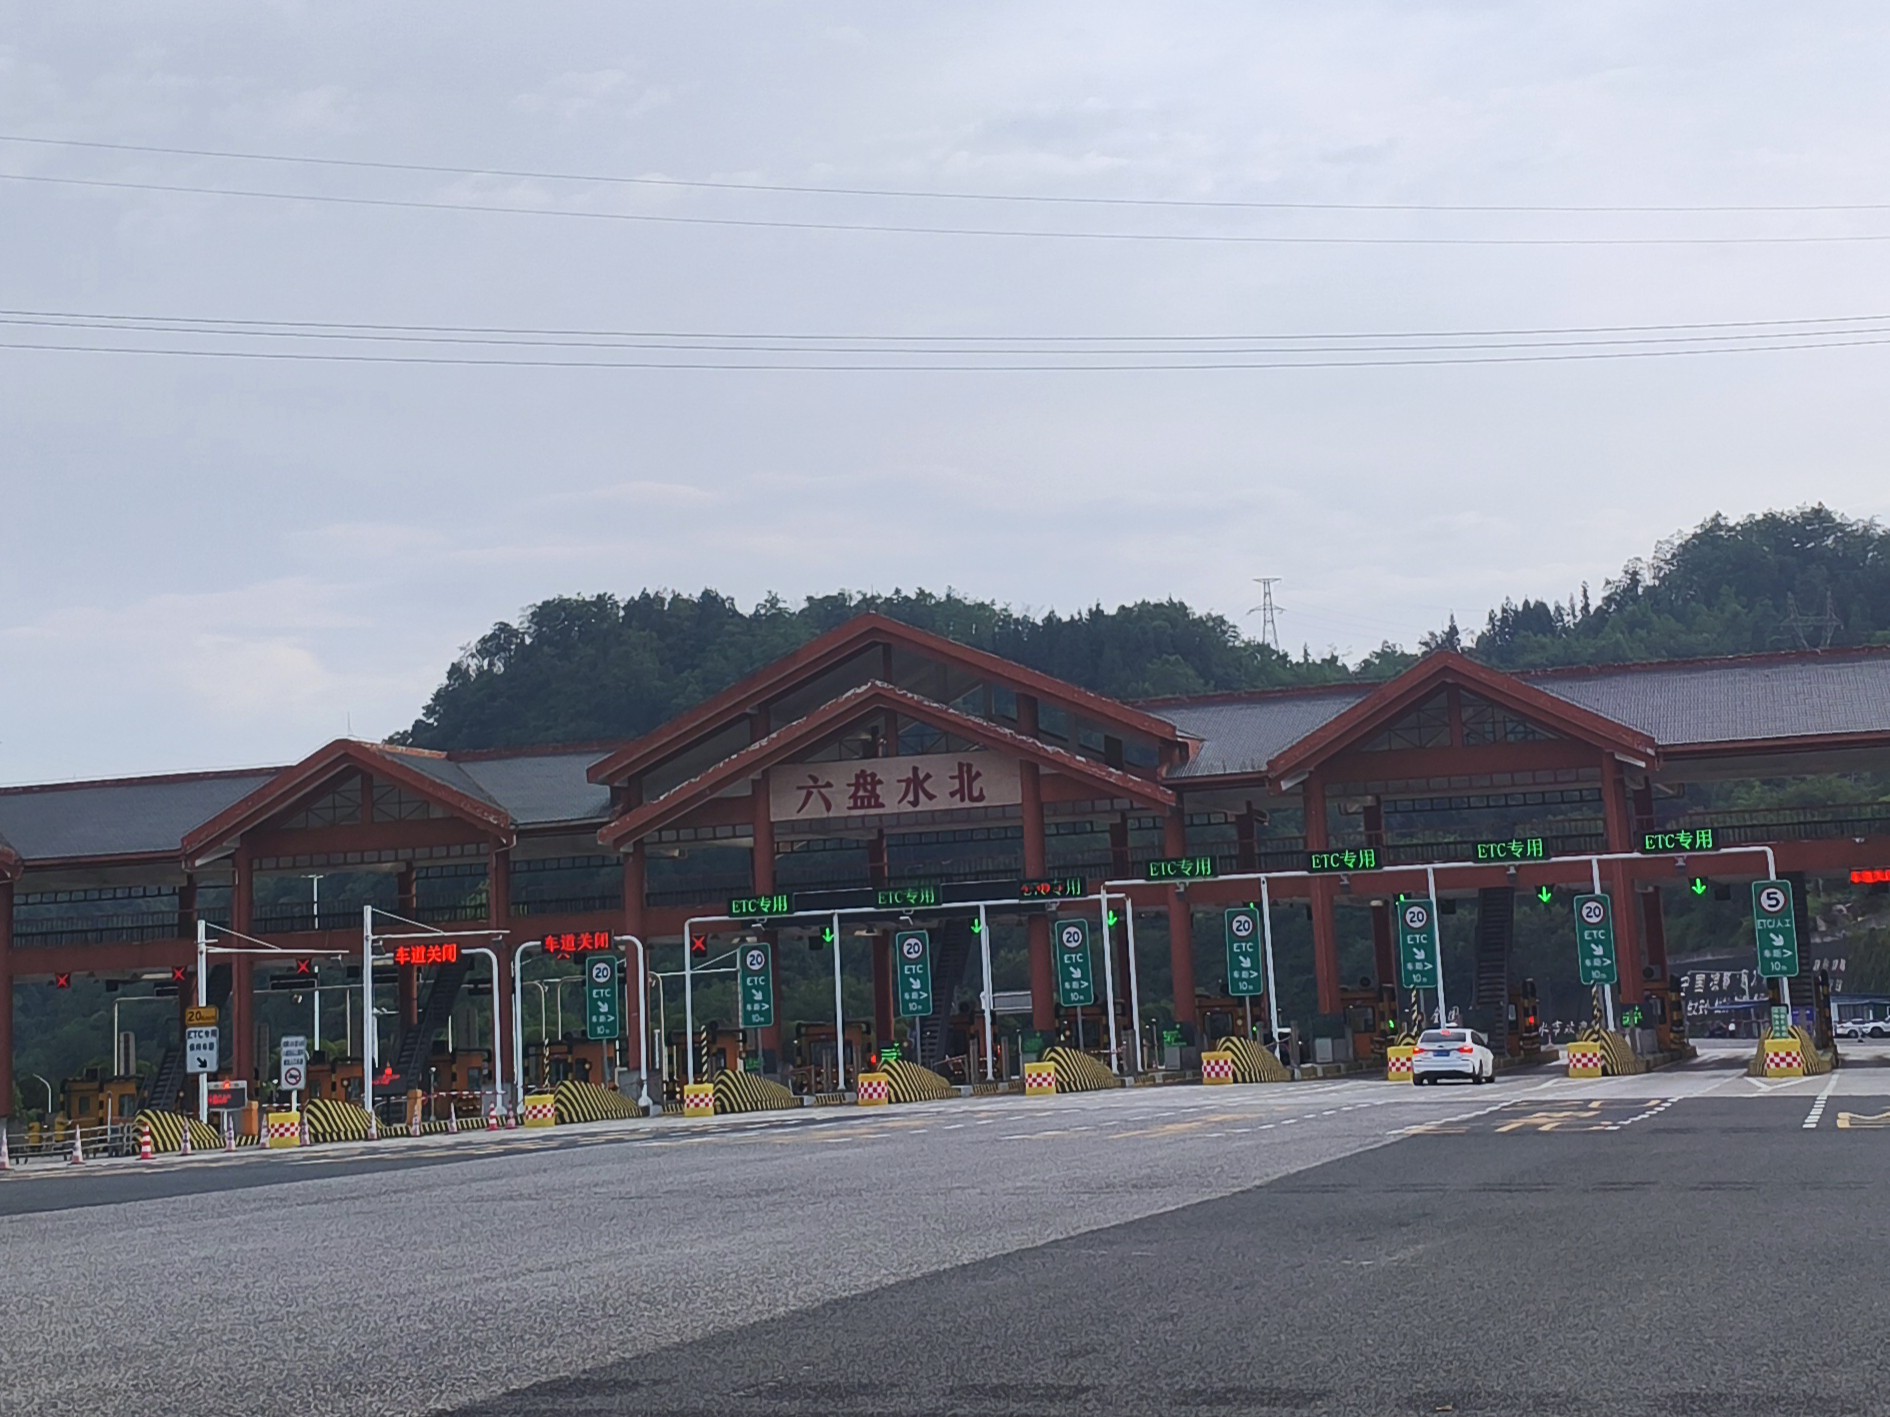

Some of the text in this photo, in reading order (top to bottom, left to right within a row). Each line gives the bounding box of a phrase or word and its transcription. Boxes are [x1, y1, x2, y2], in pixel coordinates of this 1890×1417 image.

[796, 761, 986, 814] 六盘水北
[1645, 829, 1713, 850] ETC专用
[1477, 838, 1543, 858] ETC专用
[1311, 849, 1375, 869] ETC专用
[1150, 857, 1211, 876] ETC专用
[879, 888, 935, 905] ETC专用
[1767, 892, 1781, 908] 5
[732, 894, 788, 914] ETC专用
[1409, 911, 1424, 923] 20
[1586, 905, 1601, 918] 20
[1236, 920, 1250, 932] 20
[1066, 931, 1080, 943] 20
[1407, 934, 1428, 944] ETC
[1584, 929, 1606, 940] ETC
[544, 931, 609, 953] 车道关闭
[1233, 942, 1253, 952] ETC
[395, 943, 457, 965] 车道关闭
[906, 943, 920, 955] 20
[749, 954, 763, 966] 20
[1063, 953, 1083, 963] ETC
[595, 967, 609, 978] 20
[904, 964, 923, 974] ETC
[747, 976, 765, 986] ETC
[592, 988, 611, 998] ETC
[187, 1011, 202, 1022] 20
